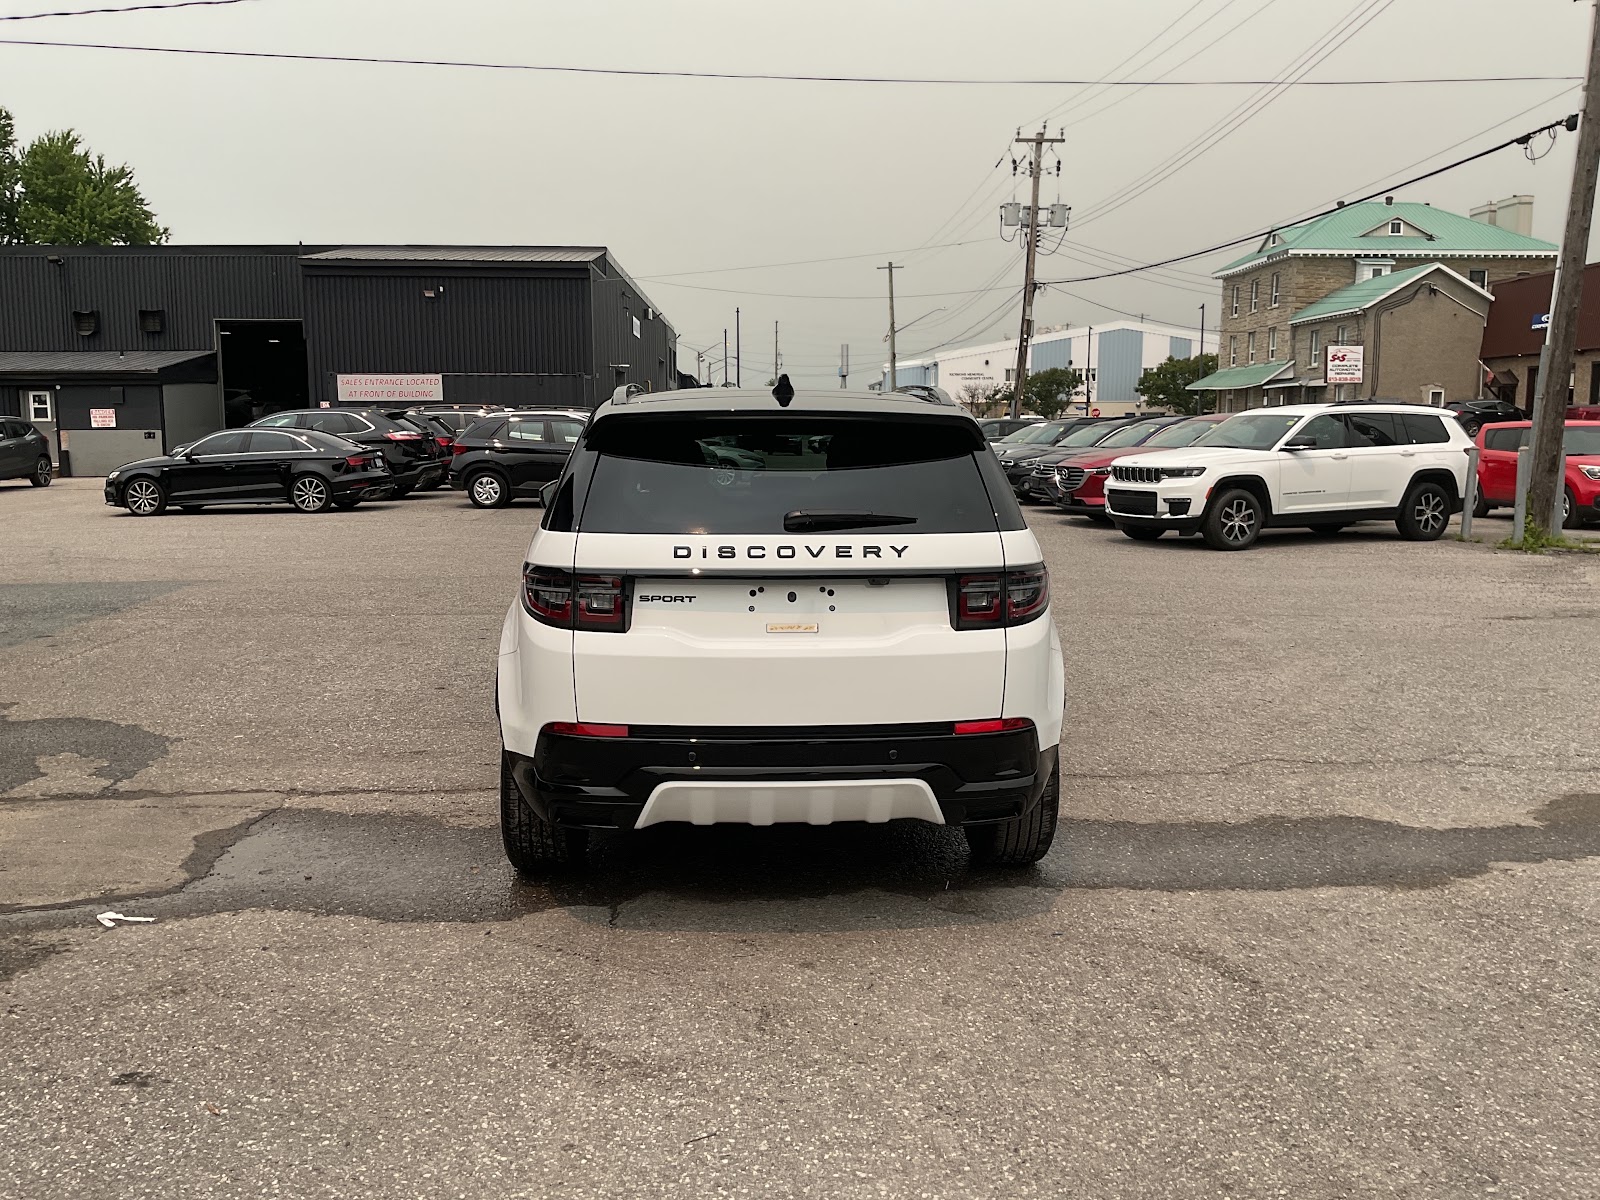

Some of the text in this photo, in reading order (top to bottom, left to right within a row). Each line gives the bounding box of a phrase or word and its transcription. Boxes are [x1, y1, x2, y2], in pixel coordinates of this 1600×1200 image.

[341, 378, 440, 386] SALES ENTRANCE LOCATED
[639, 594, 697, 603] SPORT
